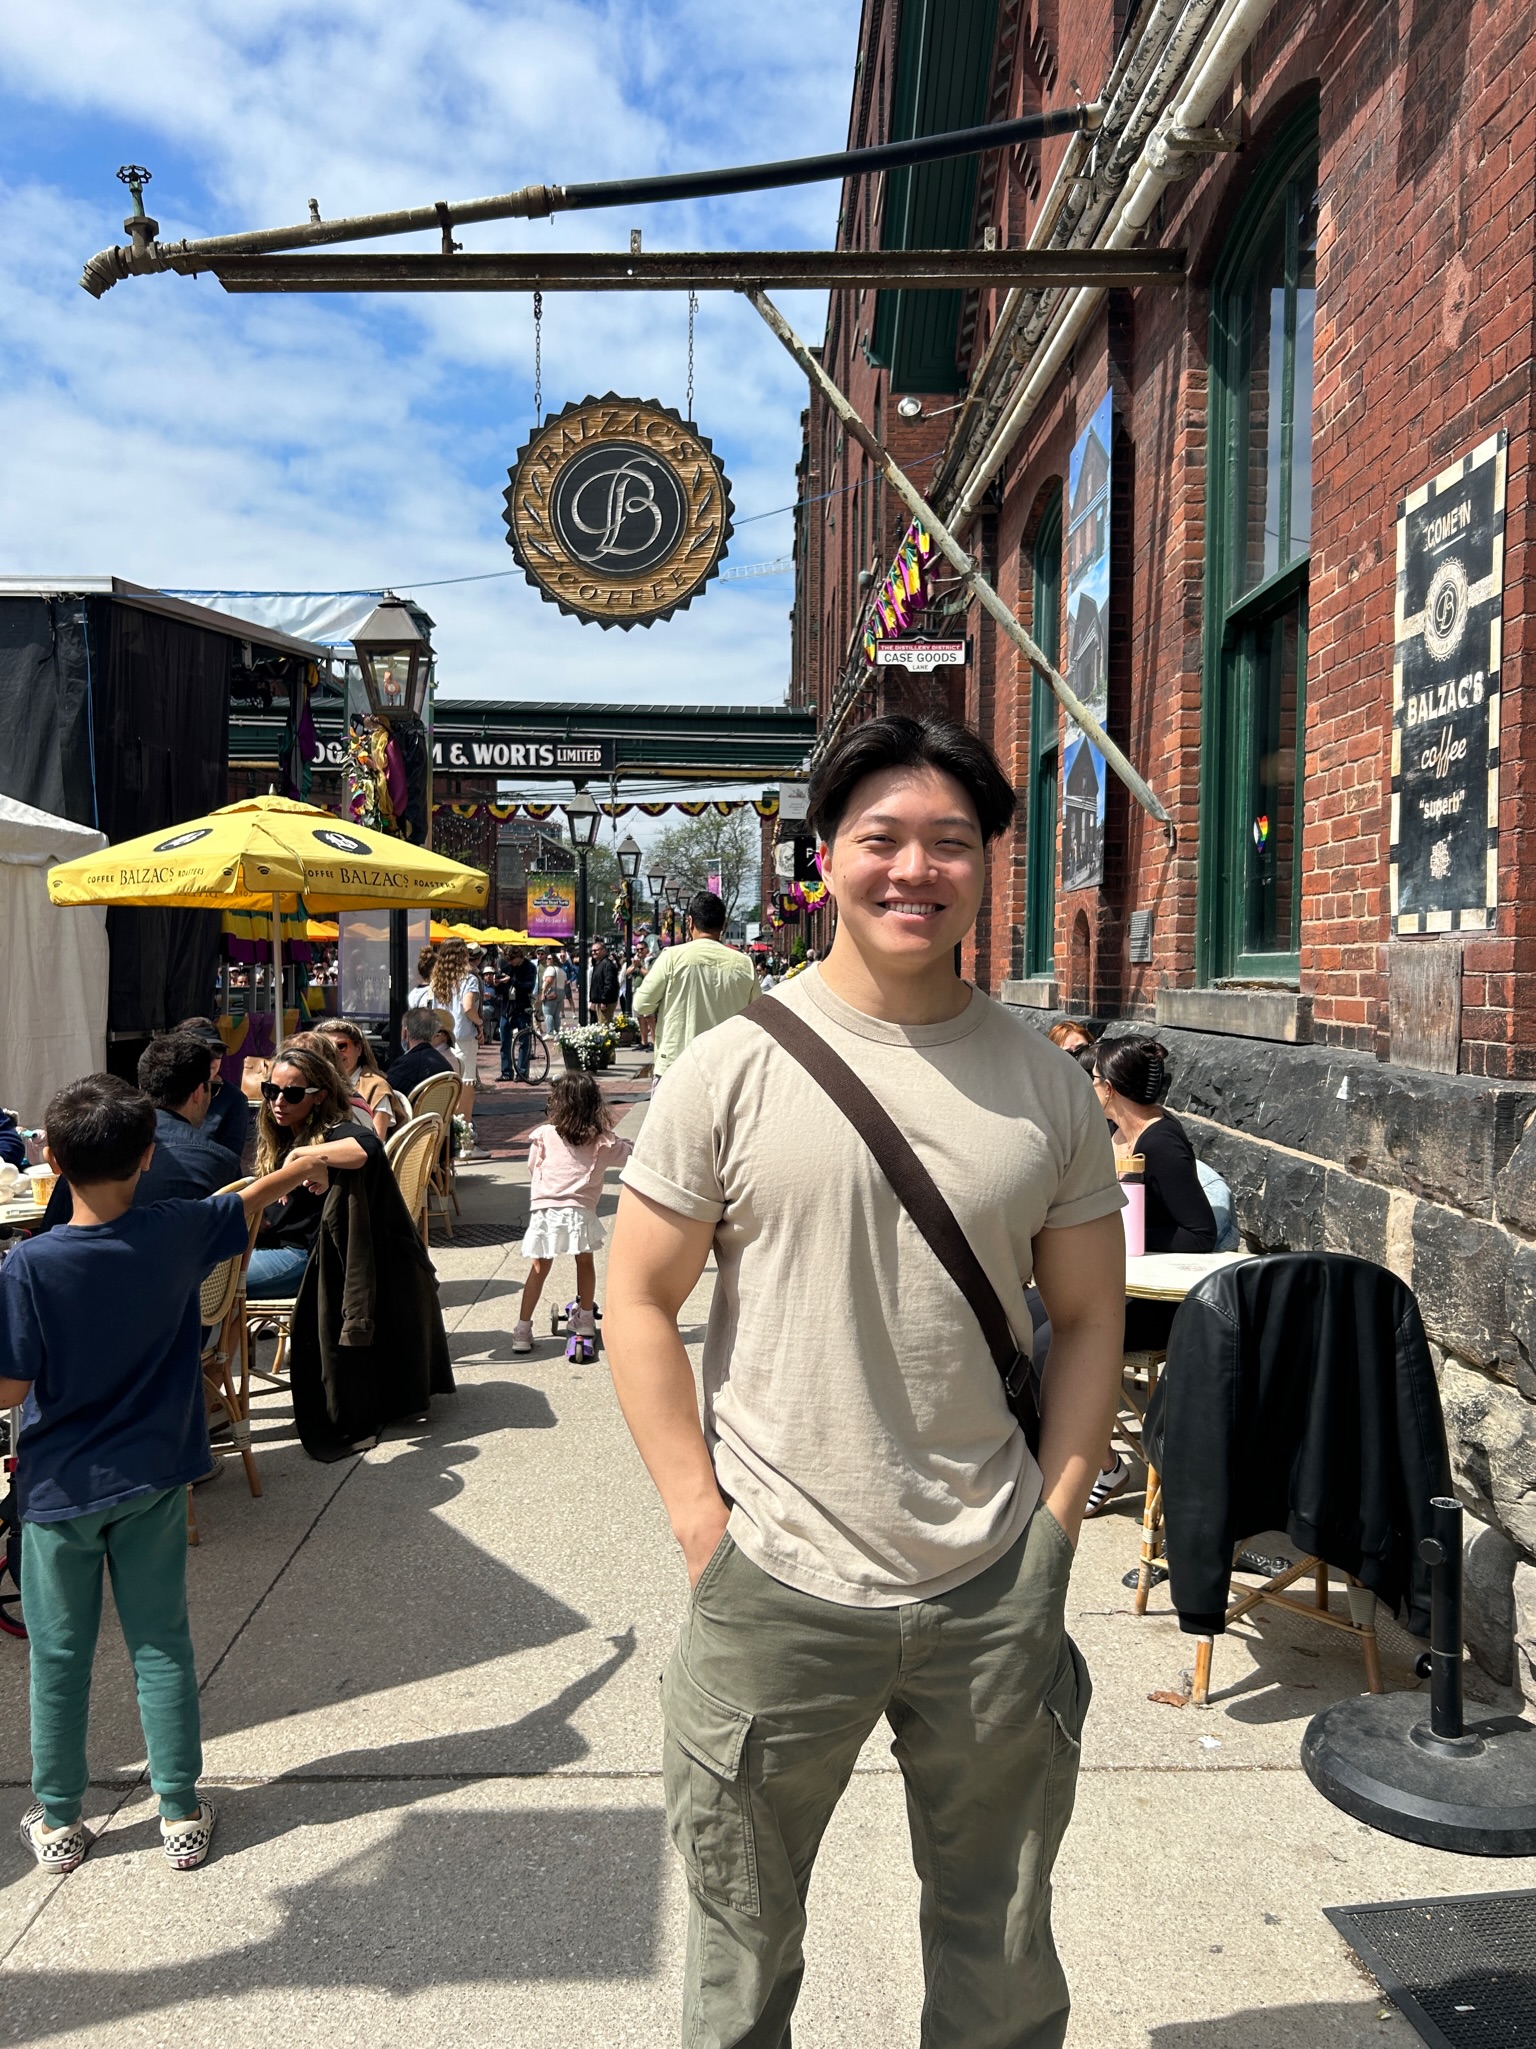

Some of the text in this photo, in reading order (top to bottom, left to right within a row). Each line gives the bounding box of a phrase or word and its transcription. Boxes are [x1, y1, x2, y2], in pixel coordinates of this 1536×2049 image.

[532, 409, 695, 472] BALZAC'S
[557, 566, 688, 608] COFFEE
[884, 653, 957, 663] CASE GOODS
[450, 743, 469, 766] &
[472, 744, 553, 767] WORTS
[557, 748, 602, 763] LIMITED
[1421, 724, 1467, 779] coffee
[87, 875, 115, 884] COFFEE
